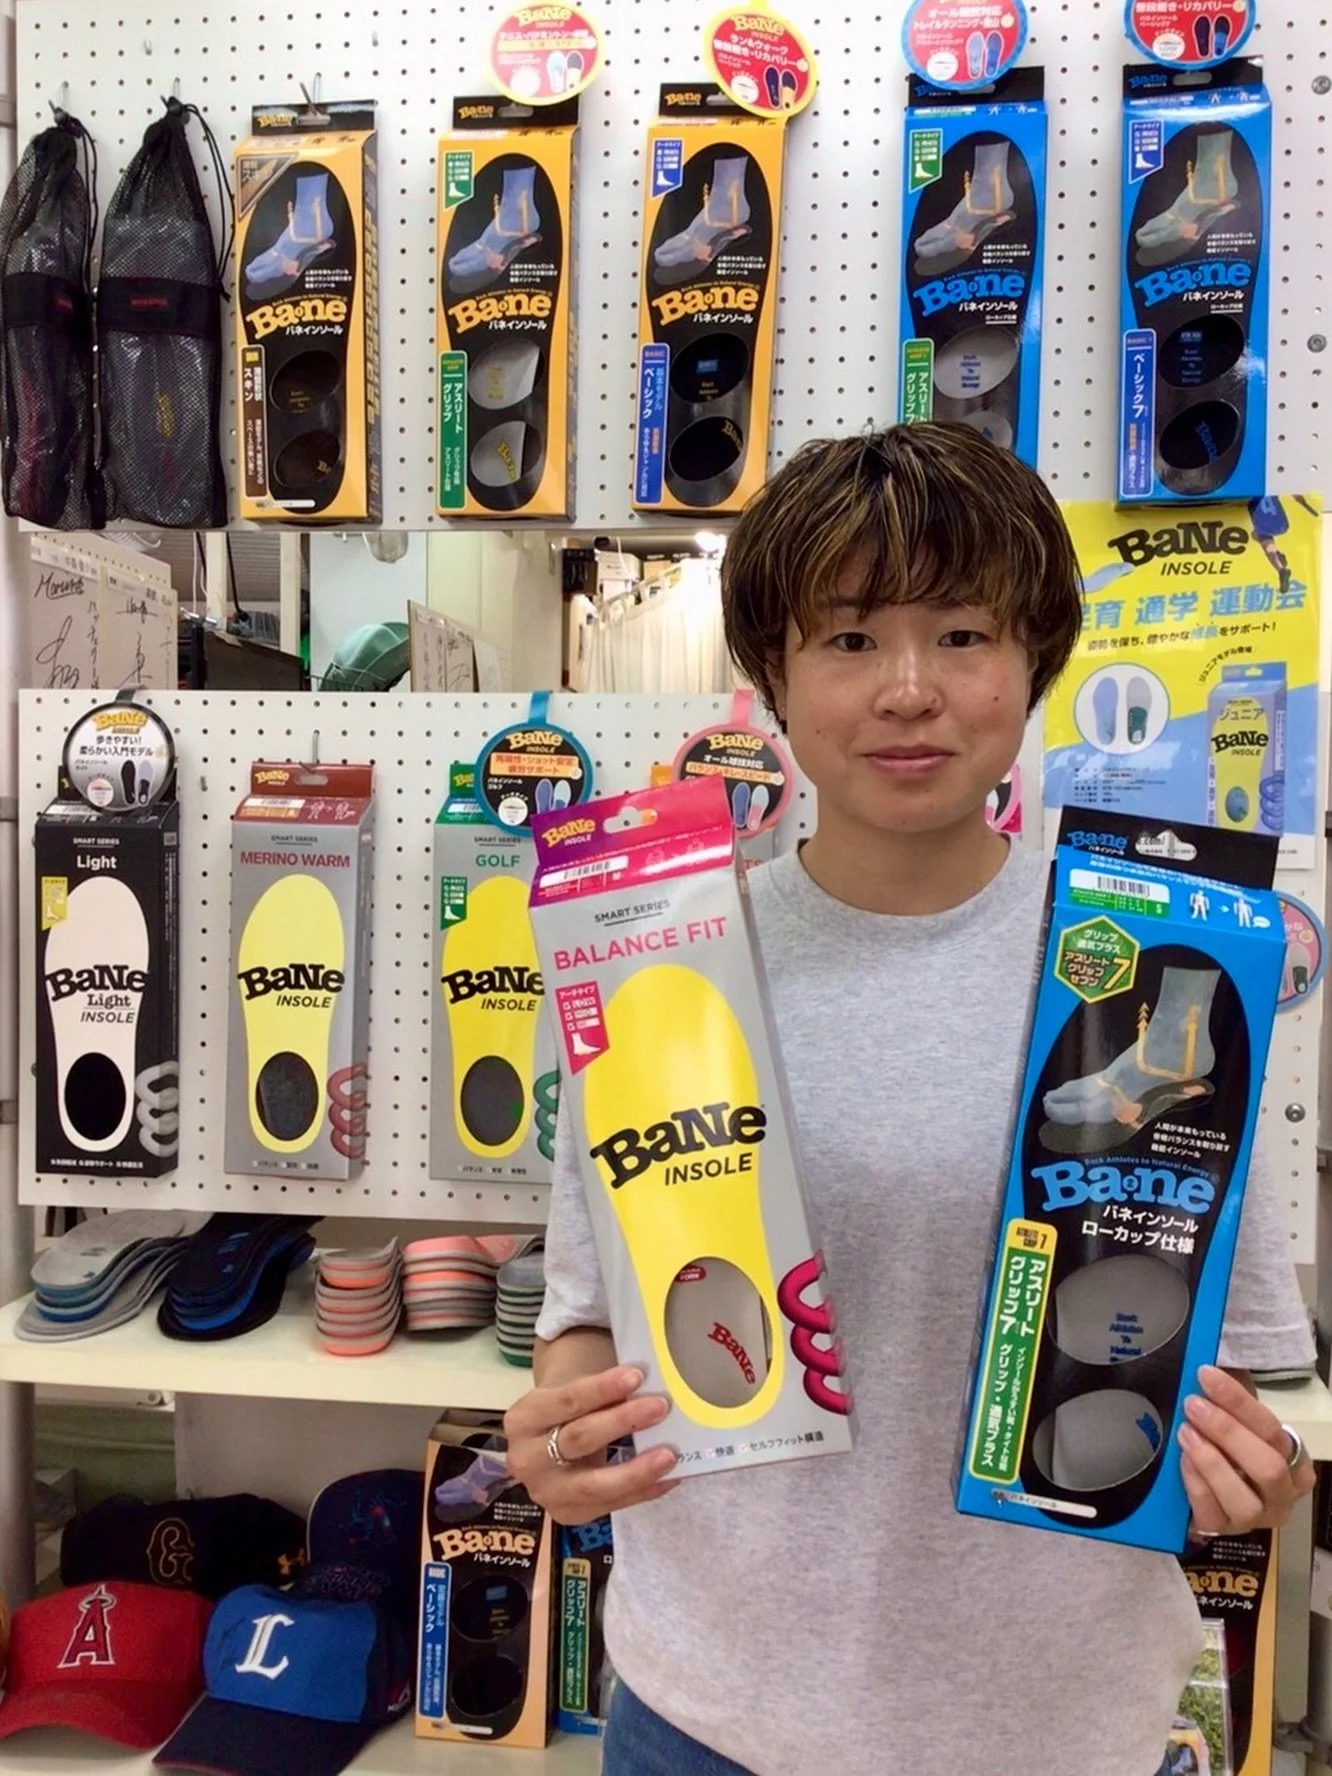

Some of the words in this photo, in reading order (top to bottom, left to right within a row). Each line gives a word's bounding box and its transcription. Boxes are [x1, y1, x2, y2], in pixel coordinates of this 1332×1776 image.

[443, 382, 453, 422] グリップ
[454, 382, 463, 435] アスリート
[1161, 561, 1232, 576] INSOLE
[1135, 590, 1198, 625] 通学
[1210, 579, 1307, 617] 運動会
[1219, 707, 1265, 721] ジュニア
[564, 834, 592, 846] INSOLE
[76, 855, 117, 871] Light
[240, 851, 298, 867] MERINO
[301, 852, 350, 868] WARM
[475, 854, 520, 868] GOLF
[594, 907, 631, 923] SMART
[633, 899, 671, 915] SERIES
[553, 926, 679, 971] BALANCE
[686, 916, 728, 944] FIT
[1084, 929, 1119, 942] グリップ
[1064, 951, 1110, 967] アスリート
[86, 993, 132, 1010] Light
[276, 995, 332, 1009] INSOLE
[481, 997, 536, 1012] INSOLE
[80, 1011, 136, 1024] INSOLE
[664, 1152, 753, 1187] INSOLE
[1103, 1205, 1199, 1234] バネインソール
[1081, 1220, 1195, 1255] ローカップ仕様
[1020, 1258, 1047, 1337] アスリート
[57, 1583, 117, 1669] A
[234, 1612, 296, 1682] L
